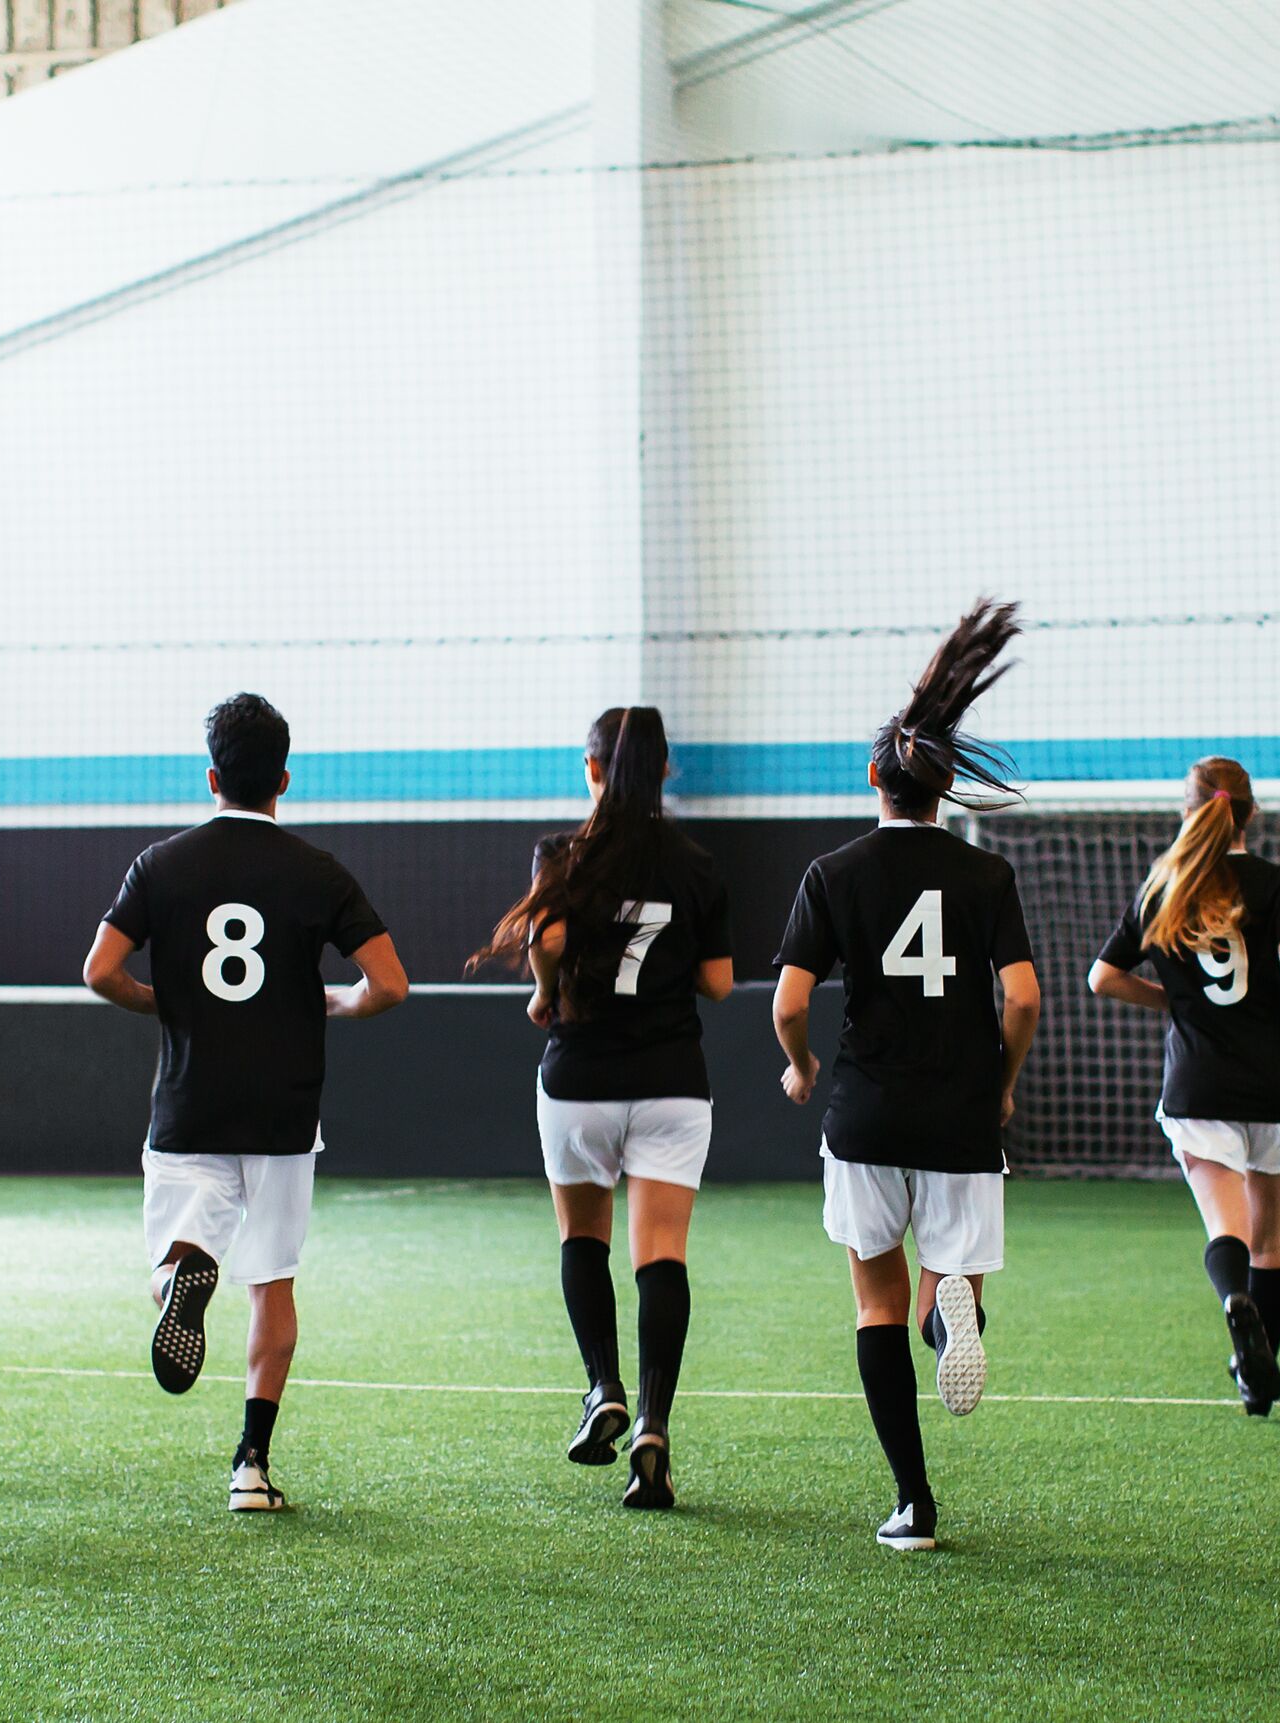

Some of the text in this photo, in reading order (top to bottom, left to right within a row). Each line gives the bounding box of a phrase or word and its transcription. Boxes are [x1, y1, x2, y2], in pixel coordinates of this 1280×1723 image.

[202, 902, 265, 1002] 8
[613, 900, 673, 995] 7
[881, 889, 957, 997] 4
[1196, 925, 1249, 1006] 9
